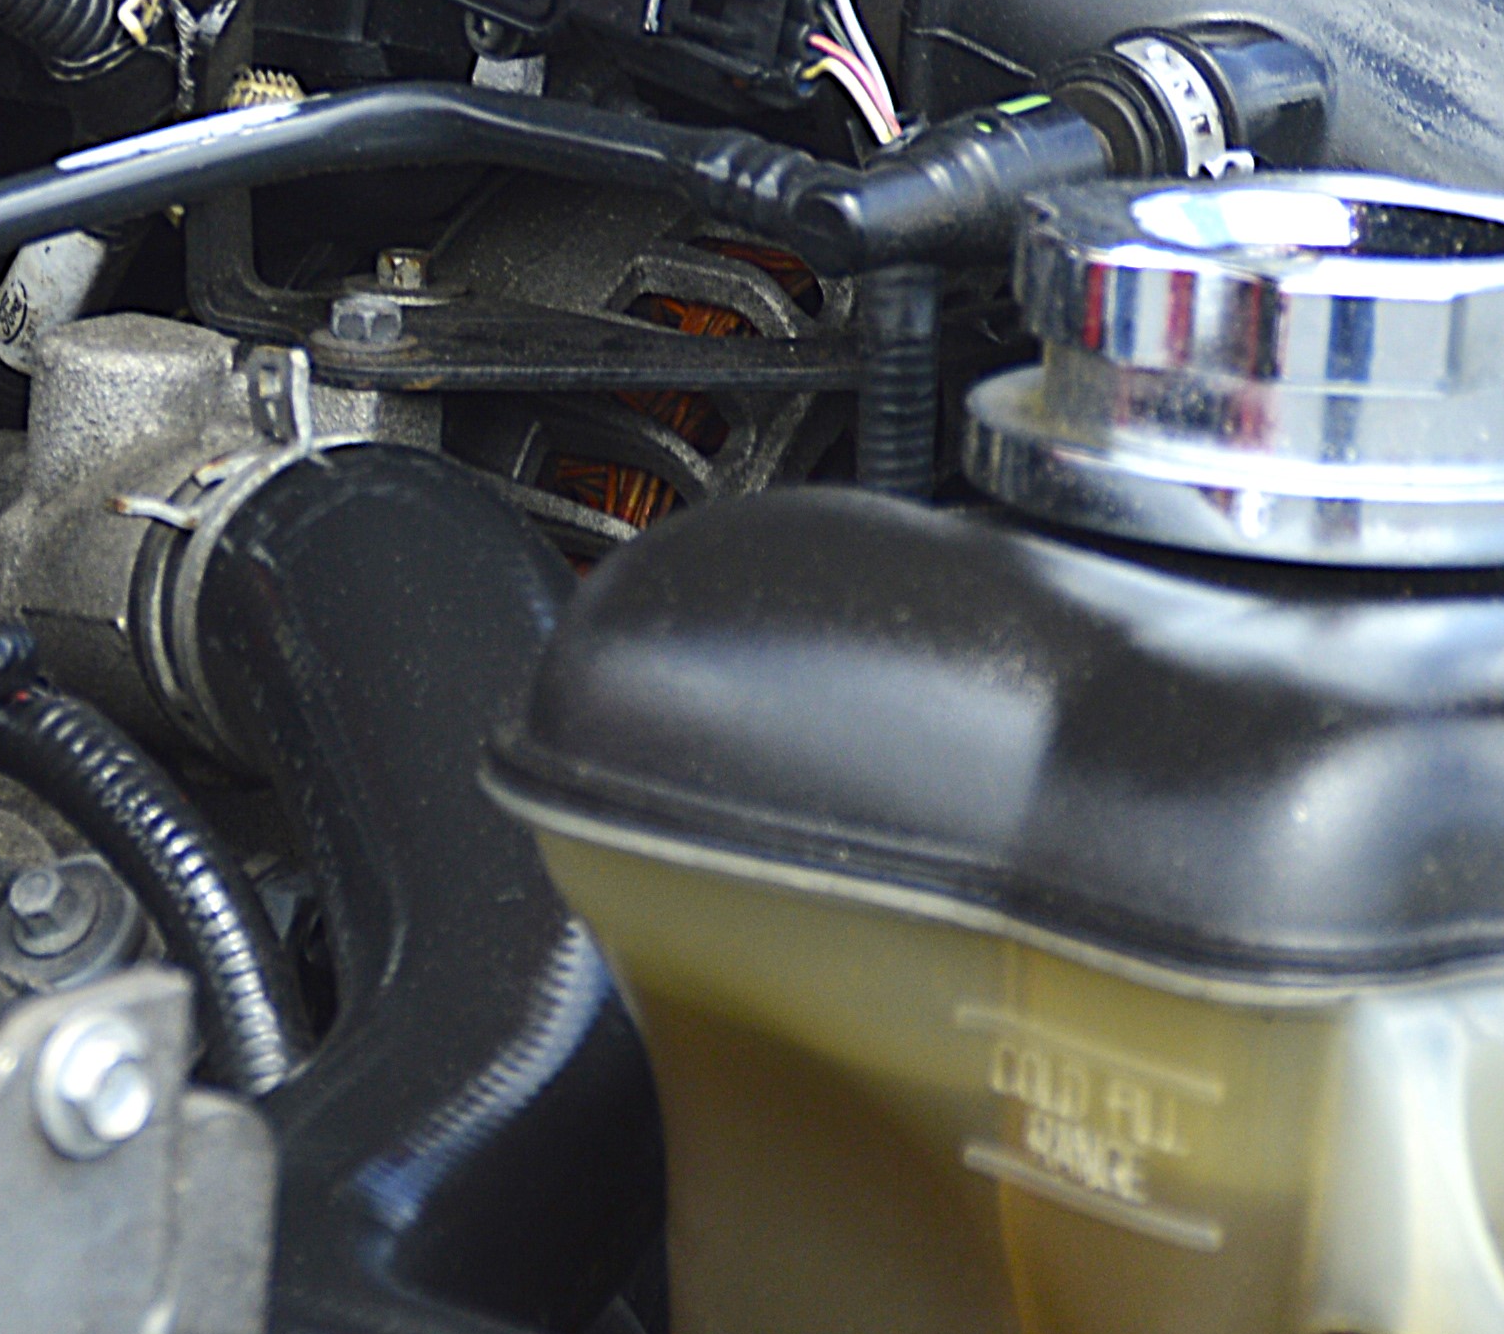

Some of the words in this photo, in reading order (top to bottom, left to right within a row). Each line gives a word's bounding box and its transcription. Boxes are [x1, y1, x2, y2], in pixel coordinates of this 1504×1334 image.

[991, 1041, 1090, 1115] COLD
[1106, 1078, 1190, 1156] FILL
[1026, 1110, 1148, 1204] RANGE
